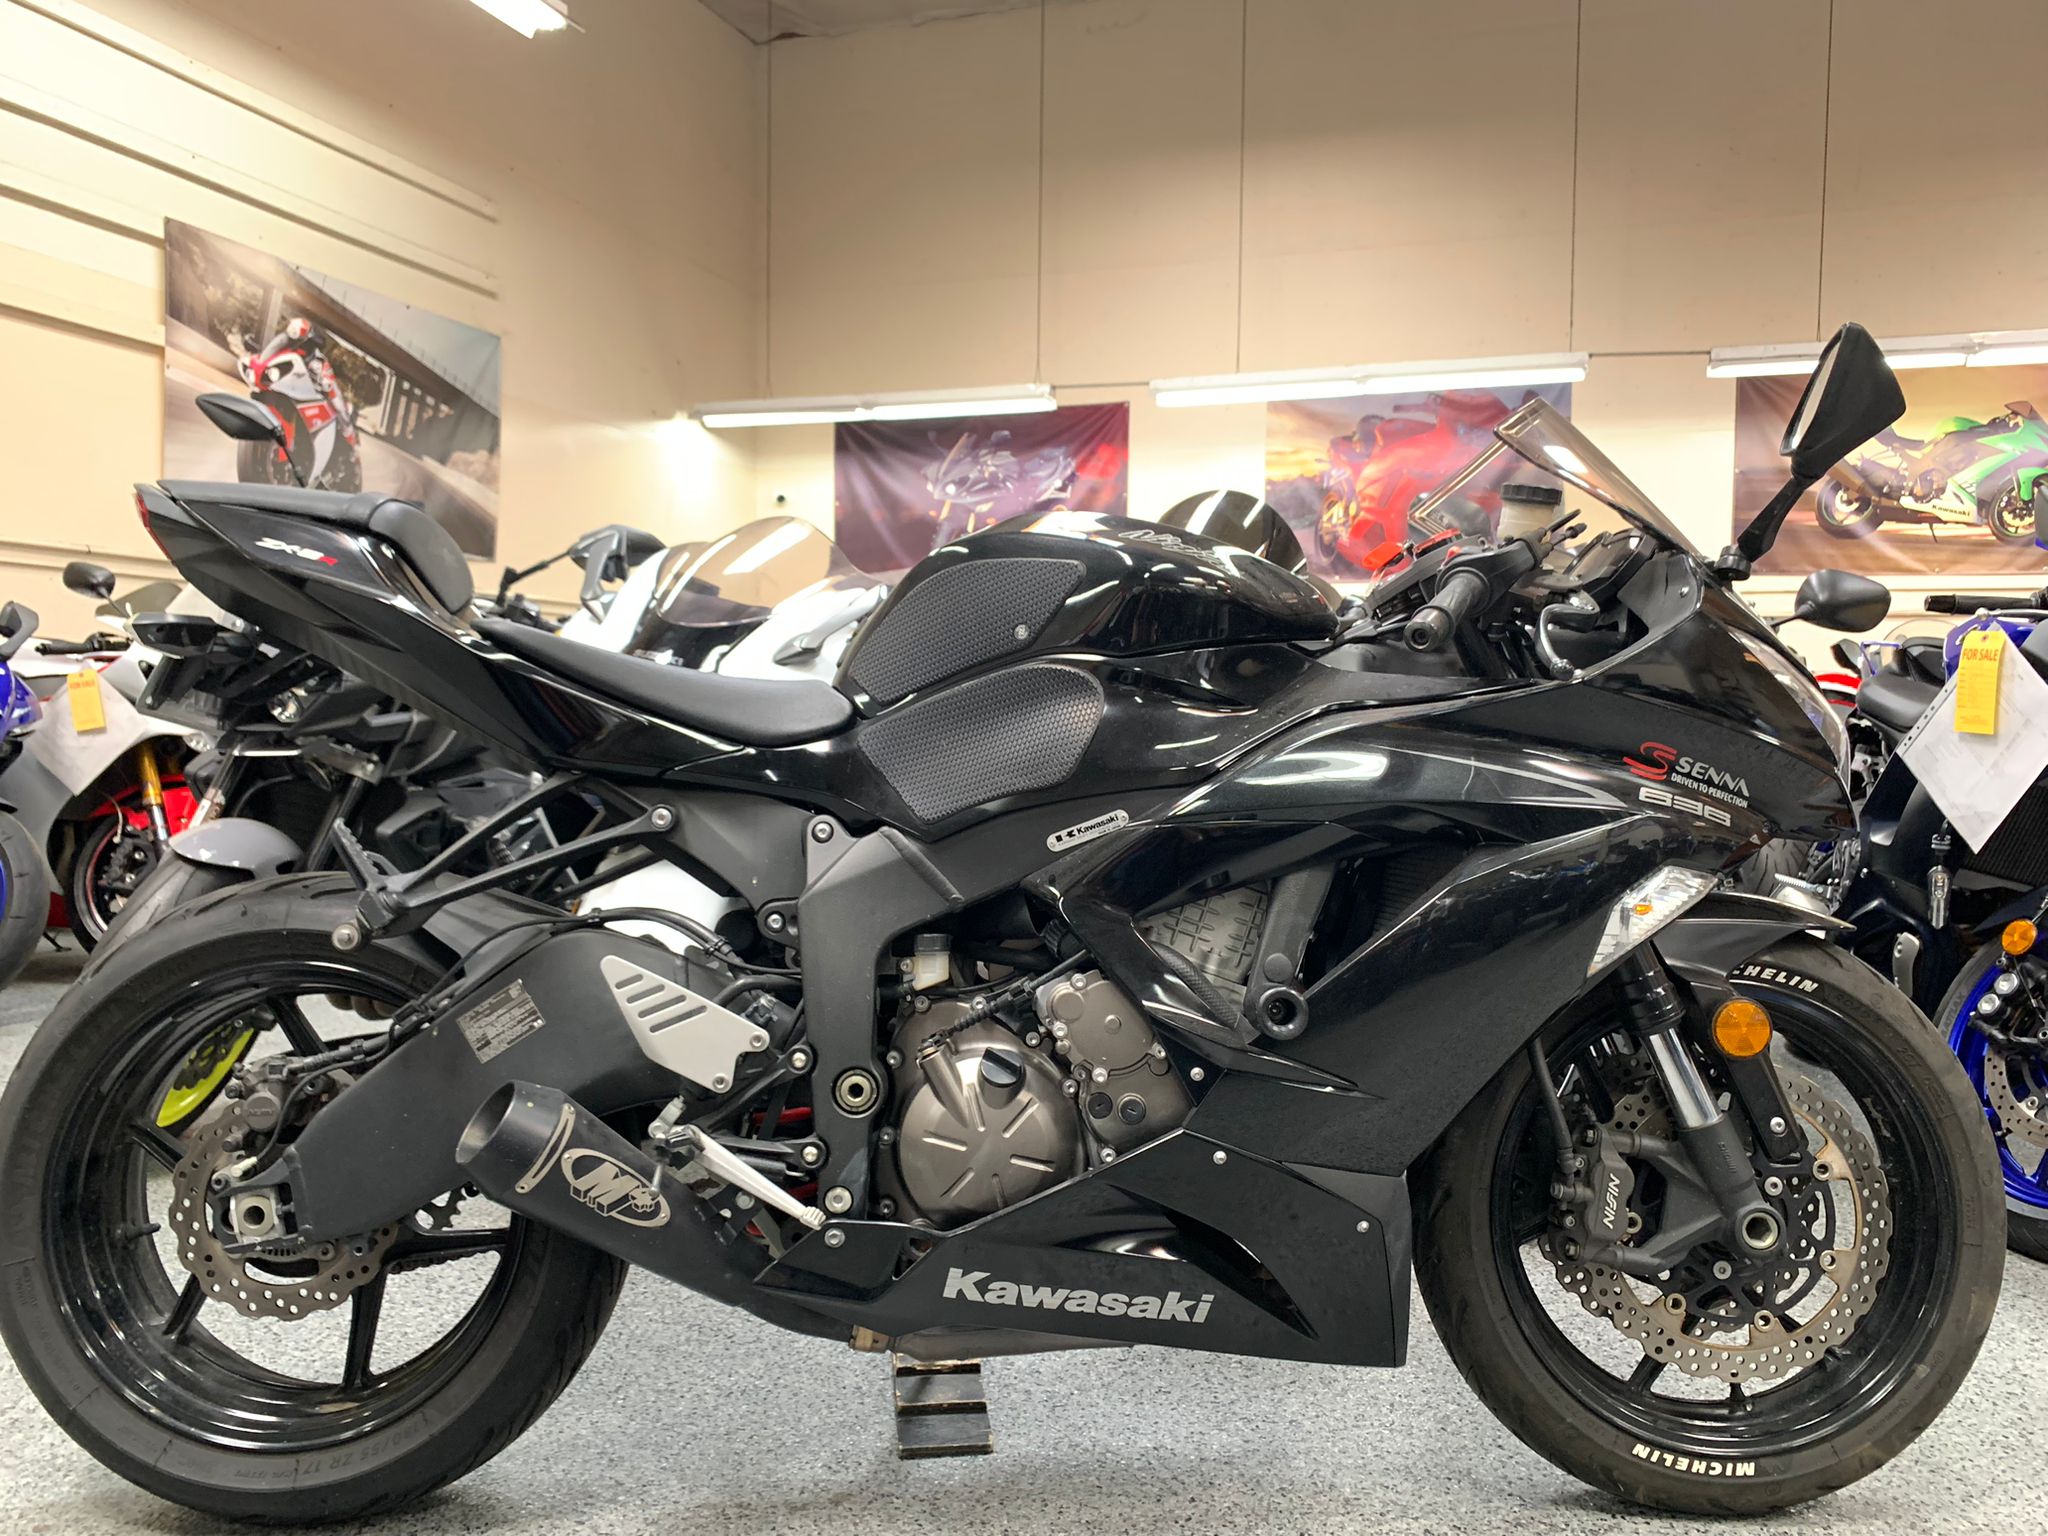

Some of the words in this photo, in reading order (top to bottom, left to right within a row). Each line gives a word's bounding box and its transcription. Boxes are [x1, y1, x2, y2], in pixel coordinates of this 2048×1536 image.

[1963, 648, 1977, 661] FOR
[1979, 648, 1999, 662] SALE
[1671, 772, 1699, 791] DRIVEN
[1699, 783, 1708, 793] TO
[1708, 786, 1749, 809] PERFECTION
[1675, 756, 1750, 797] SENNA
[1076, 813, 1119, 836] Kawasaki
[1638, 786, 1731, 827] 636
[942, 1267, 1215, 1324] Kawasaki
[1631, 1443, 1756, 1477] MICHELIN
